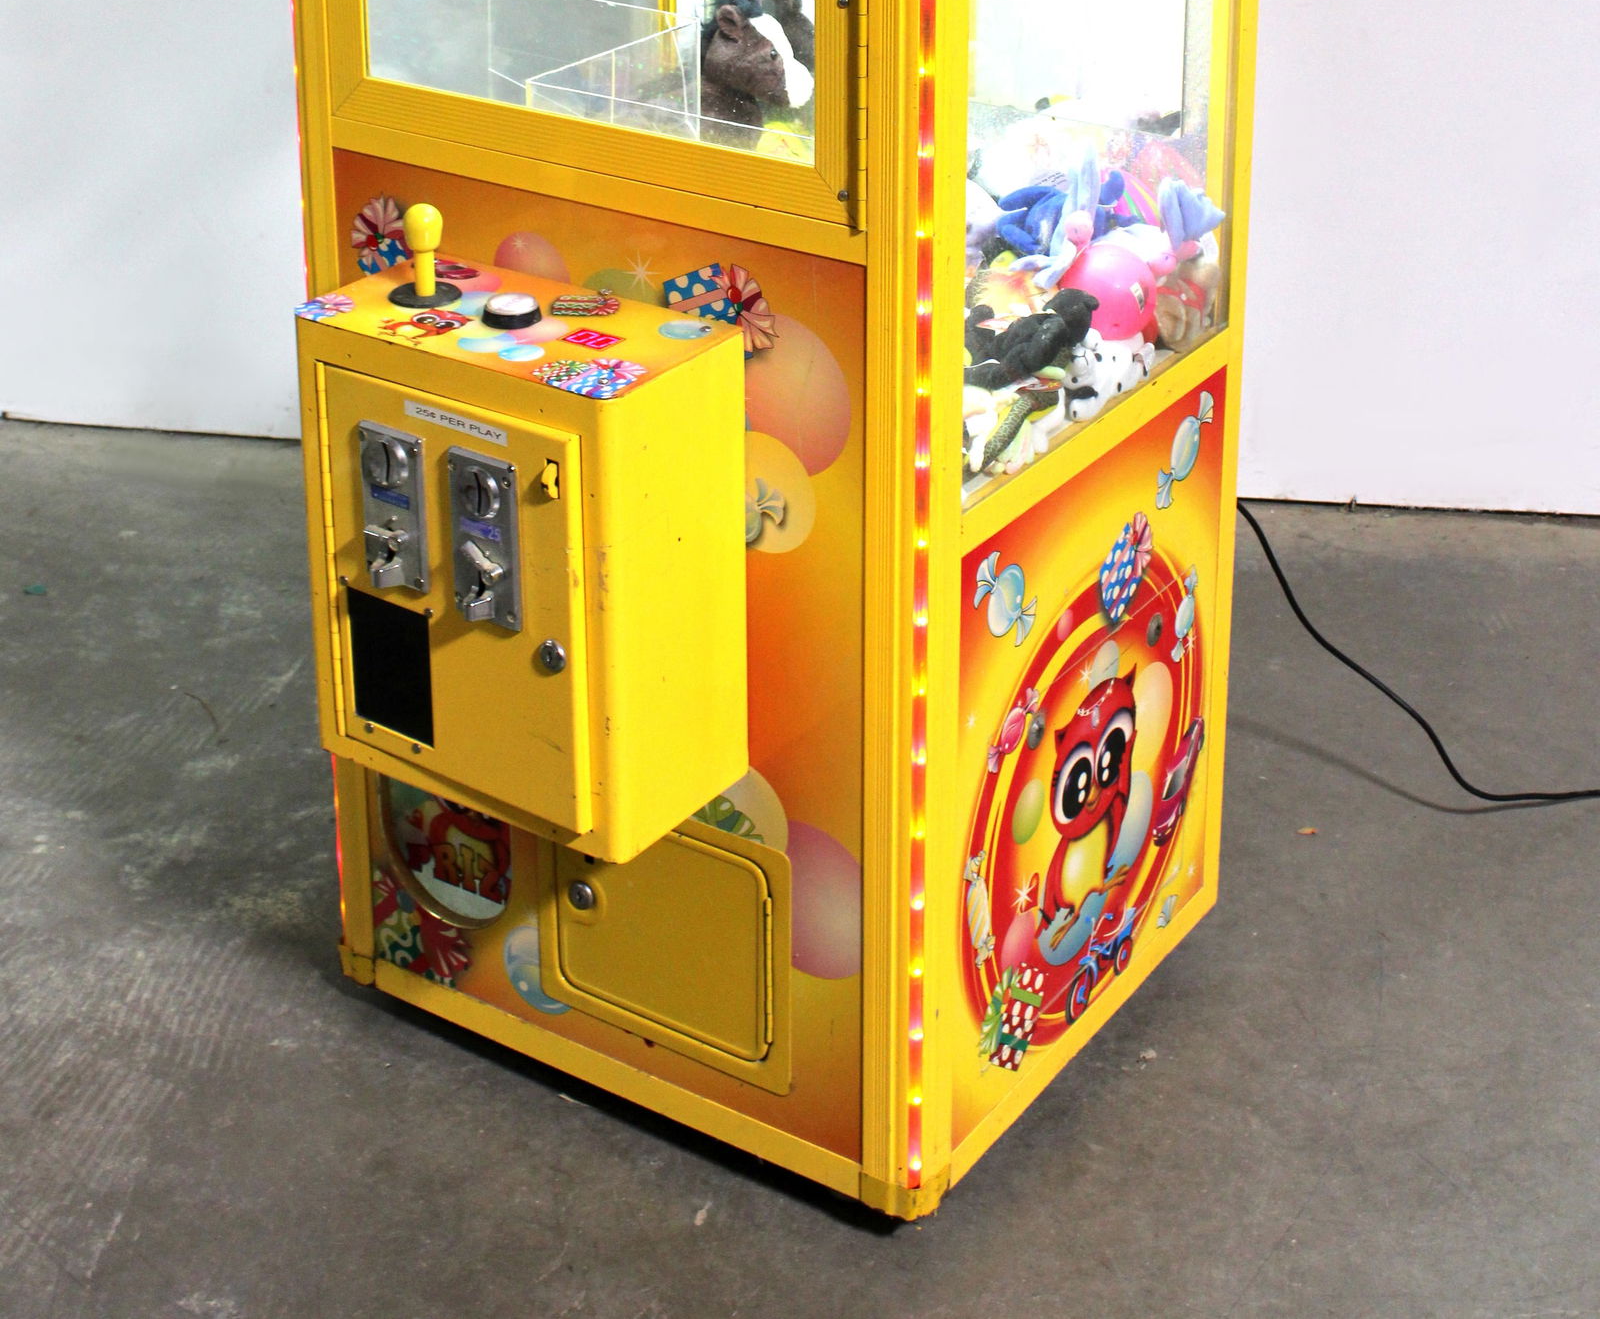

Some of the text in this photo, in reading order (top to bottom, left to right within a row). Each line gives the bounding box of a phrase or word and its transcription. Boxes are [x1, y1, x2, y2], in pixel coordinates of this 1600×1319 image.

[440, 414, 466, 429] PER
[469, 424, 502, 440] PLAY
[407, 841, 511, 905] PRIZ
